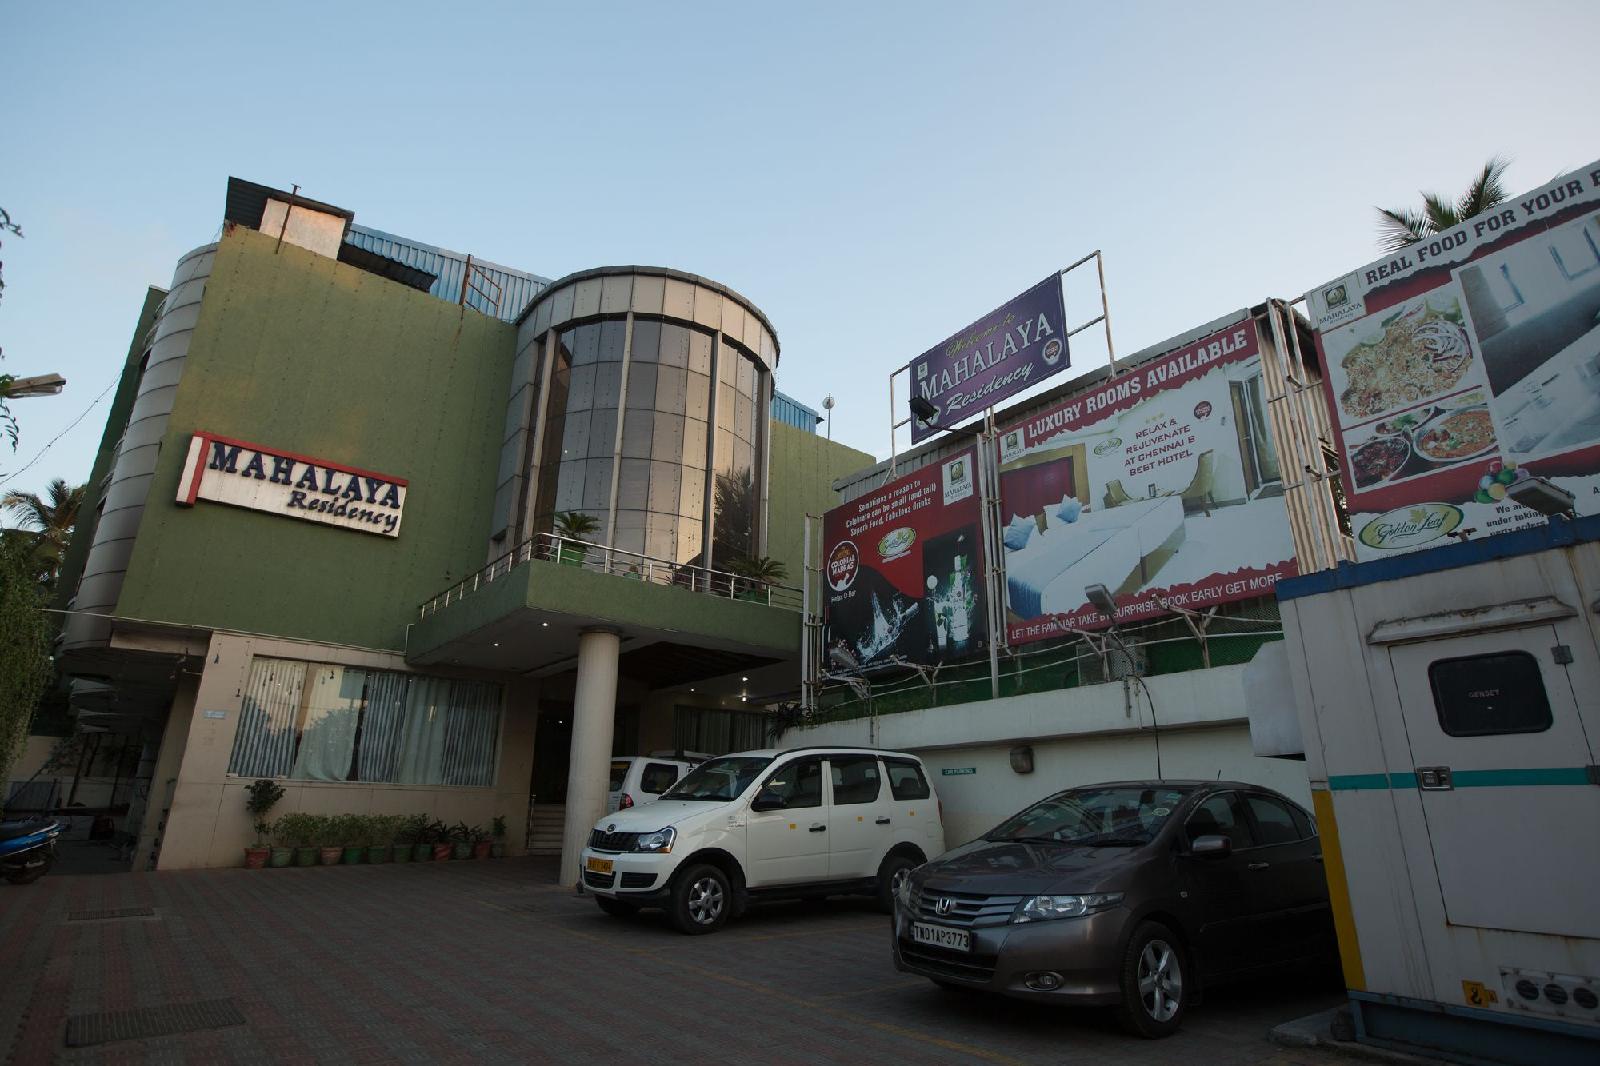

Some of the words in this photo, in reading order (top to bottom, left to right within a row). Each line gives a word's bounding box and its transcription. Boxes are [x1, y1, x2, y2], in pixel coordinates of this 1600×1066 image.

[1365, 256, 1413, 285] REAL
[1416, 230, 1468, 262] FOOD
[1473, 208, 1516, 237] FOR
[1521, 179, 1584, 216] YOUR
[919, 312, 1054, 400] MAHALAYA
[945, 362, 1035, 416] Residency
[1028, 401, 1082, 438] LUXURY
[1086, 376, 1141, 416] ROOMS
[1146, 329, 1248, 389] AVAILABLE
[1126, 424, 1191, 454] REJUVENATE
[1135, 421, 1167, 439] RELAX
[209, 442, 401, 509] MAHALAYA
[1124, 456, 1135, 467] AT
[1157, 449, 1192, 466] HOTEL
[287, 489, 398, 533] Residency
[1011, 628, 1025, 639] LET
[1026, 624, 1040, 636] THE
[1078, 612, 1097, 625] TAKE
[1191, 585, 1223, 602] EARLY
[1225, 580, 1247, 594] GET
